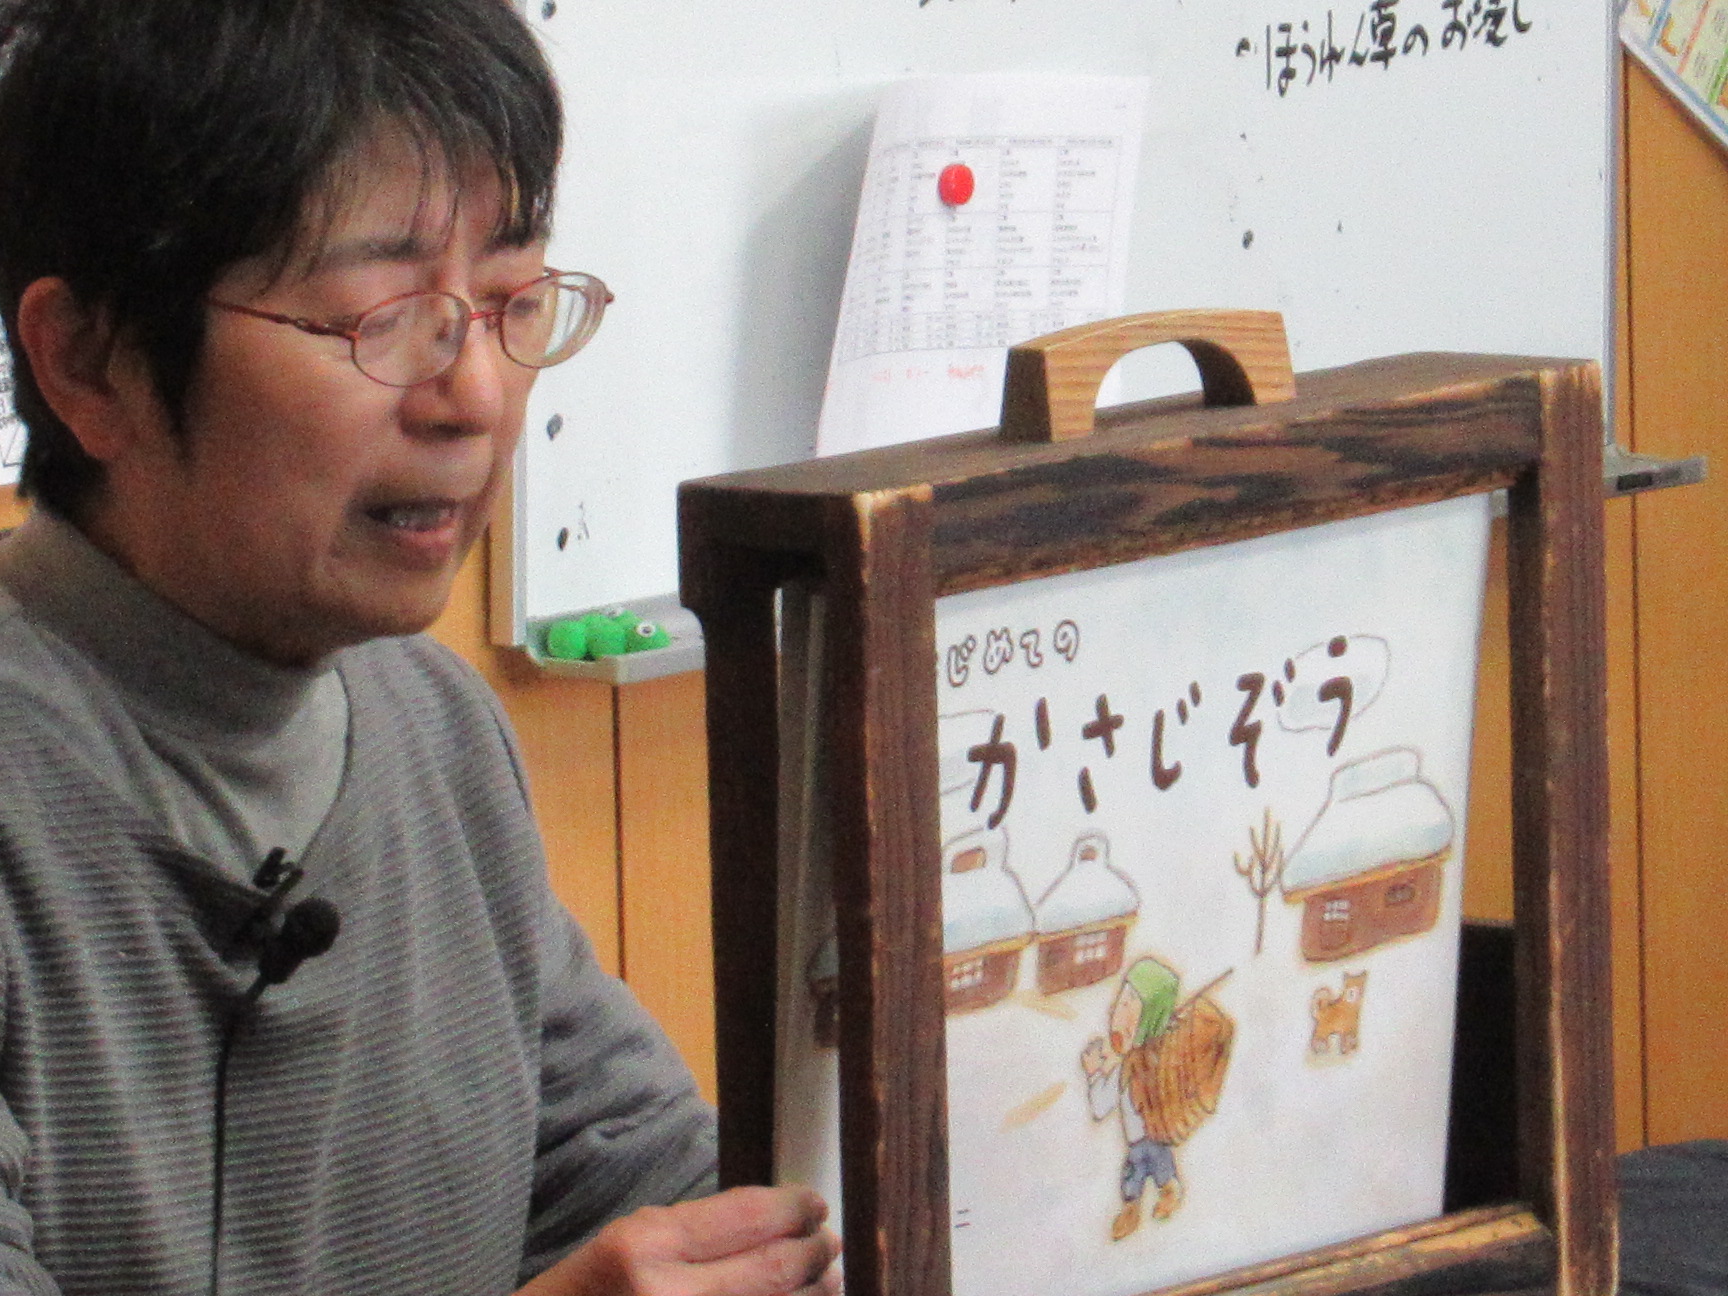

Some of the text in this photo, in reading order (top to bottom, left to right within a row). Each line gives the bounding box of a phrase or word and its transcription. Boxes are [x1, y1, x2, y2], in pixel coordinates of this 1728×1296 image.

[947, 619, 1080, 688] じめての
[967, 635, 1355, 831] かさじぞう
